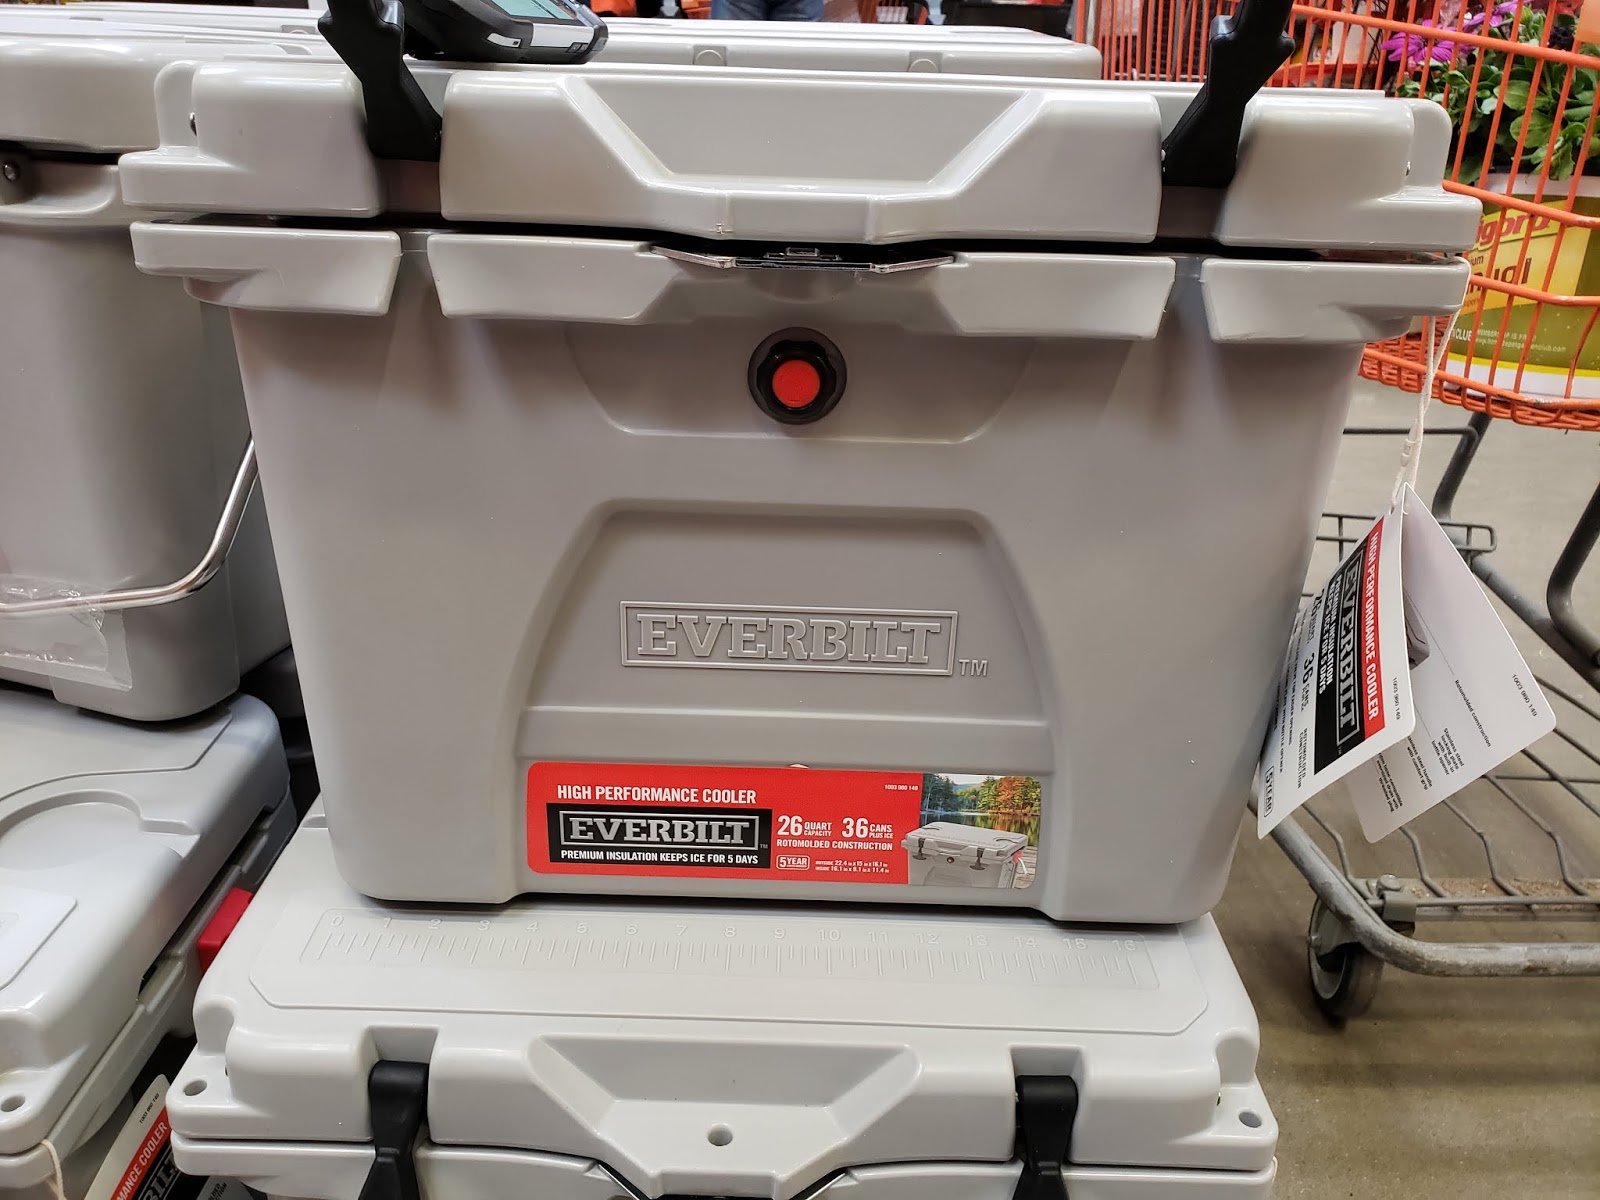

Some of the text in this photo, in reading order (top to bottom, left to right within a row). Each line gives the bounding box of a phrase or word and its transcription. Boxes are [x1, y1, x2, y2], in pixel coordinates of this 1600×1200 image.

[1476, 214, 1551, 246] igoro
[1326, 574, 1342, 685] PREMIUM INSULATION
[1365, 532, 1379, 720] HIGH PERFORMANCE COOLER
[637, 613, 988, 677] EVERBILT TM
[1321, 632, 1329, 656] FOR
[1340, 560, 1359, 729] EVERBILT
[1303, 652, 1315, 684] 36
[1320, 655, 1327, 665] 5
[1319, 664, 1327, 694] DAYS
[1455, 679, 1491, 747] Rotomolded construction
[557, 785, 757, 804] HIGH PERFORMANCE COOLER
[569, 817, 750, 845] EVERBILT
[777, 815, 832, 836] 26 QUART
[841, 817, 893, 838] 36 CANS
[561, 850, 759, 864] PREMIUM INSULATION KEEPS ICE FOR 5 DAYS
[776, 839, 893, 851] ROTOMOLDED CONSTRUCTION
[779, 857, 808, 868] 5 YEAR
[330, 914, 1136, 951] 0 1 2 3 4 5 6 7 8 9 10 11 12 13 14 15 16
[138, 1121, 168, 1166] COOLER
